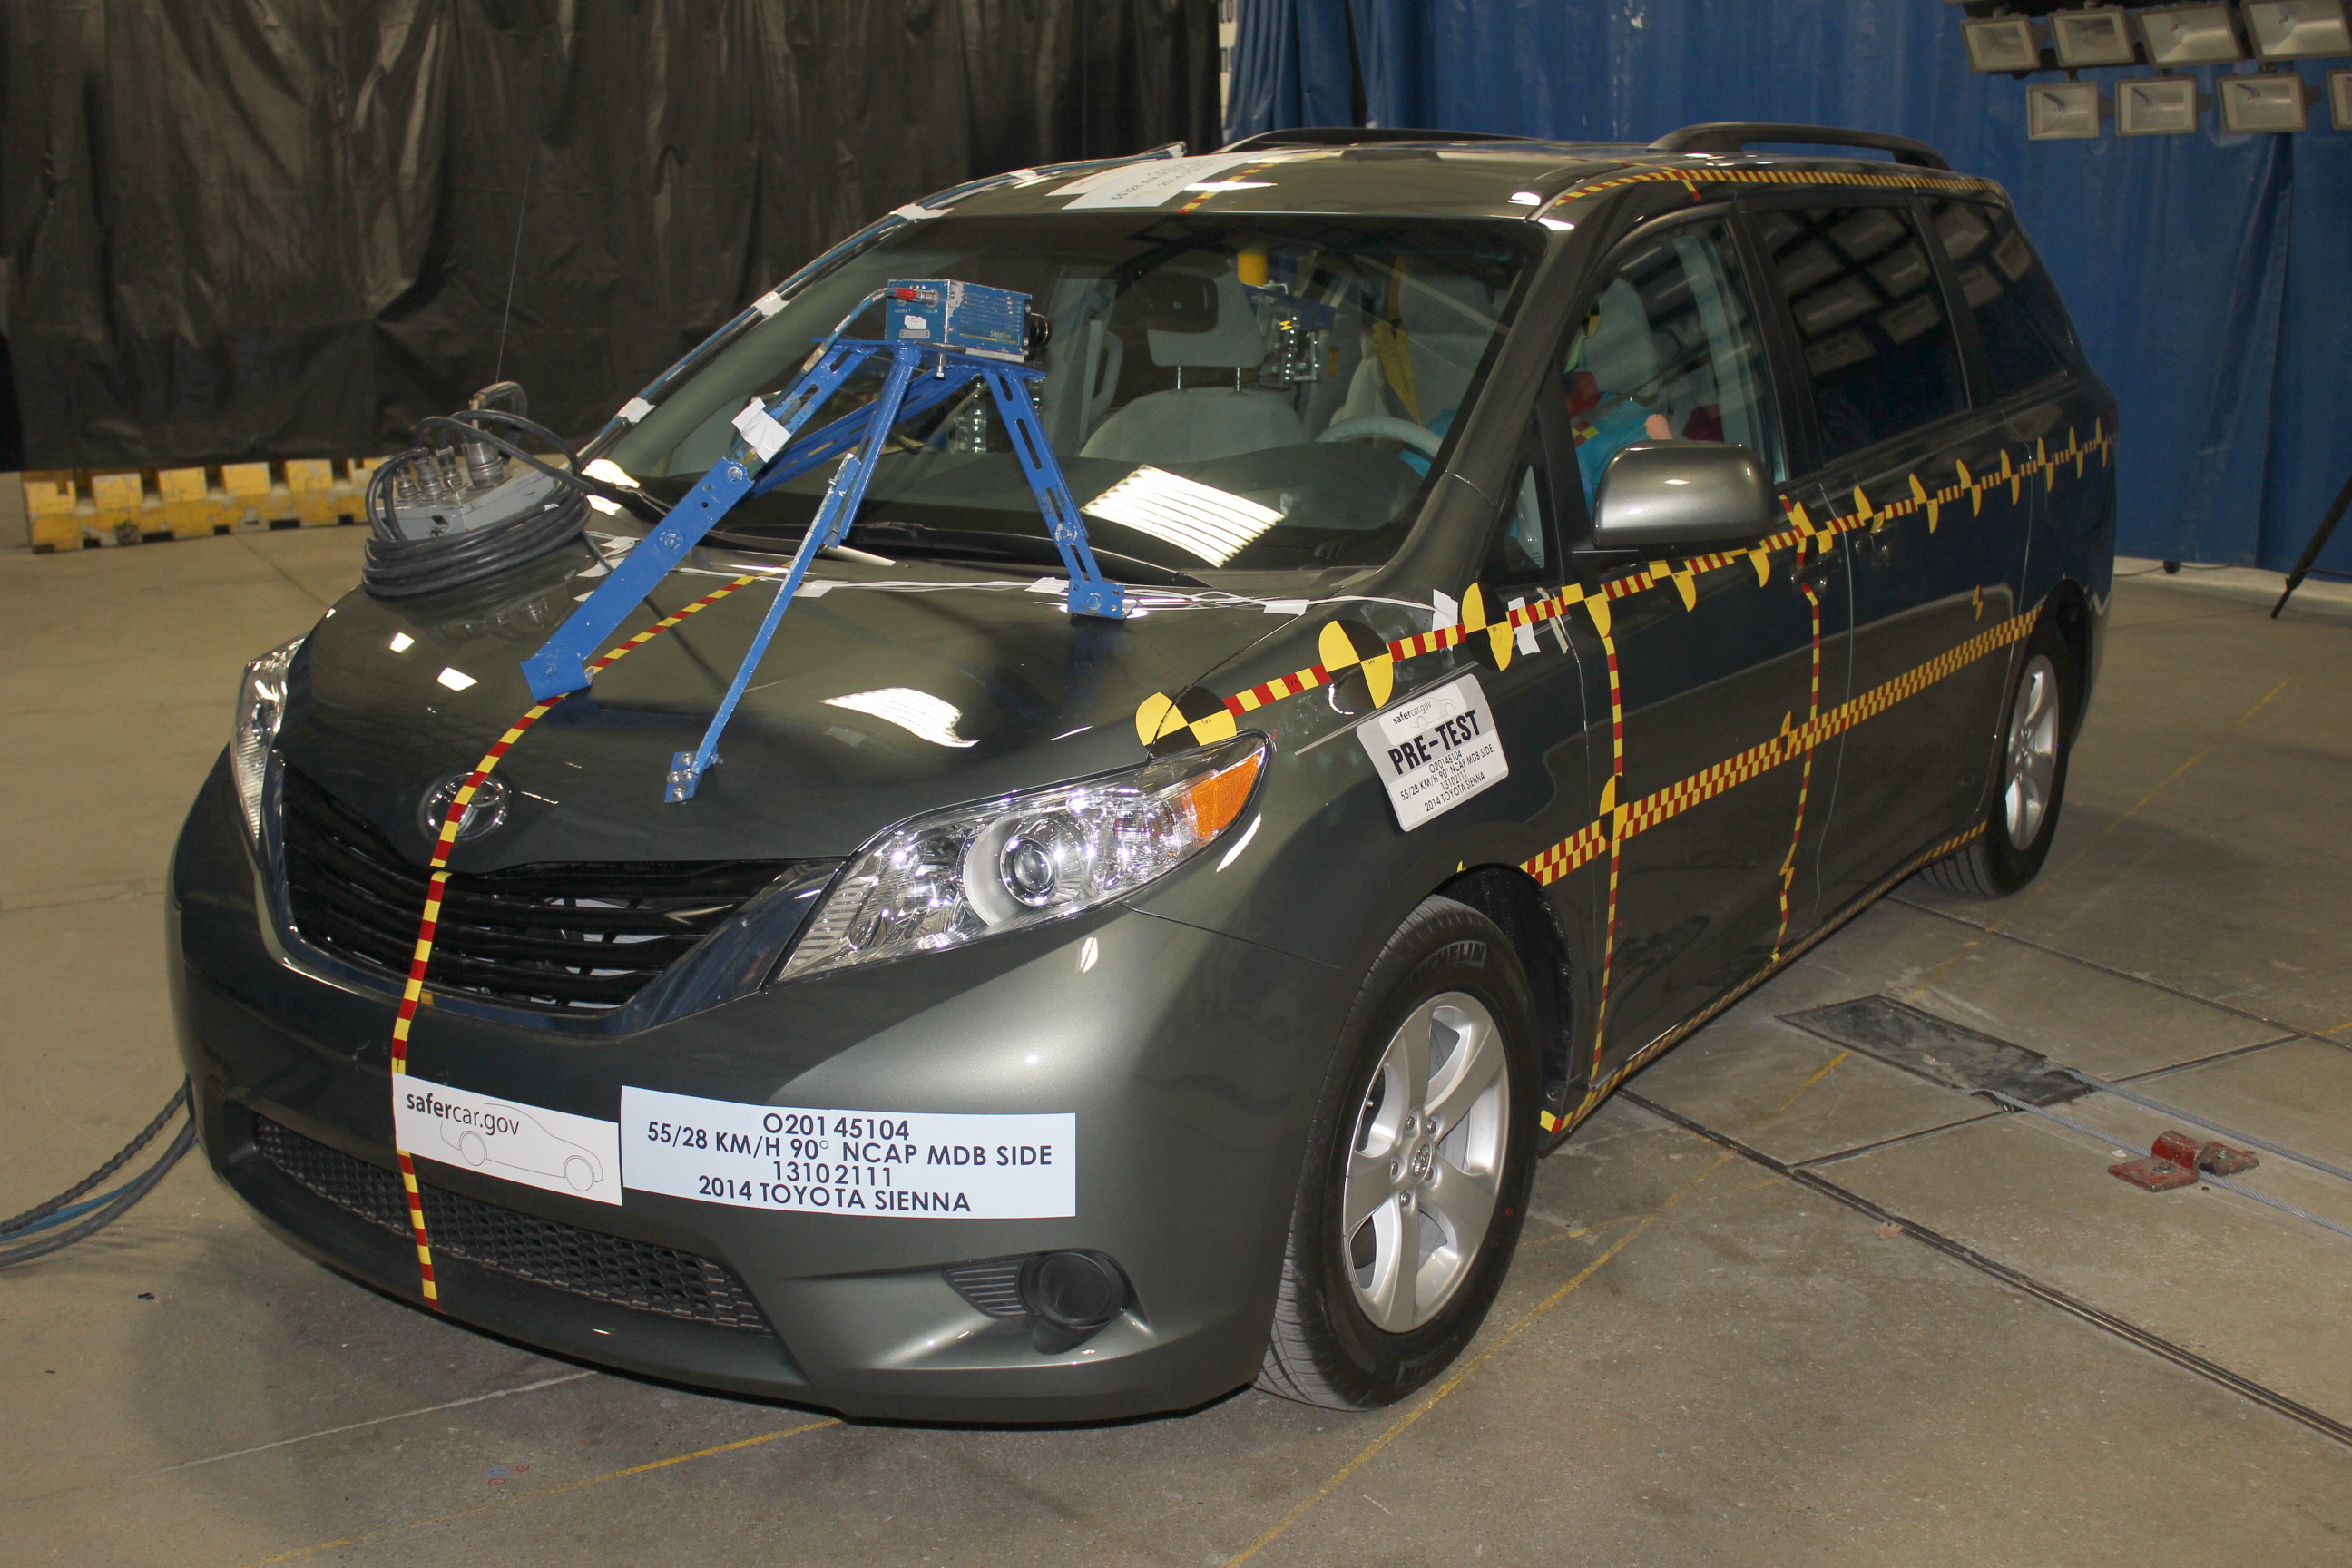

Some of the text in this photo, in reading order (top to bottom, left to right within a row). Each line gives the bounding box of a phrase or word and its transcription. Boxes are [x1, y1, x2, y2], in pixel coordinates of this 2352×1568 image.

[1393, 701, 1432, 725] safercar.gov
[1387, 709, 1480, 775] PRE-TEST
[1400, 783, 1420, 800] 55/28
[1419, 773, 1439, 790] KM/H
[1449, 758, 1466, 775] NCAP
[1466, 750, 1480, 765] MDB
[1480, 743, 1494, 758] SIDE
[1424, 771, 1486, 812] 2014 TOYOTA SIENNA
[1440, 769, 1467, 790] 13102111
[407, 1093, 520, 1136] safercar.gov
[647, 1121, 708, 1148] 55/28
[715, 1131, 780, 1159] KM/H
[842, 1141, 917, 1164] NCAP
[926, 1144, 987, 1166] MDB
[995, 1144, 1052, 1166] SIDE
[698, 1174, 972, 1211] 2014 TOYOTA SIENNA
[773, 1161, 891, 1187] 13102111
